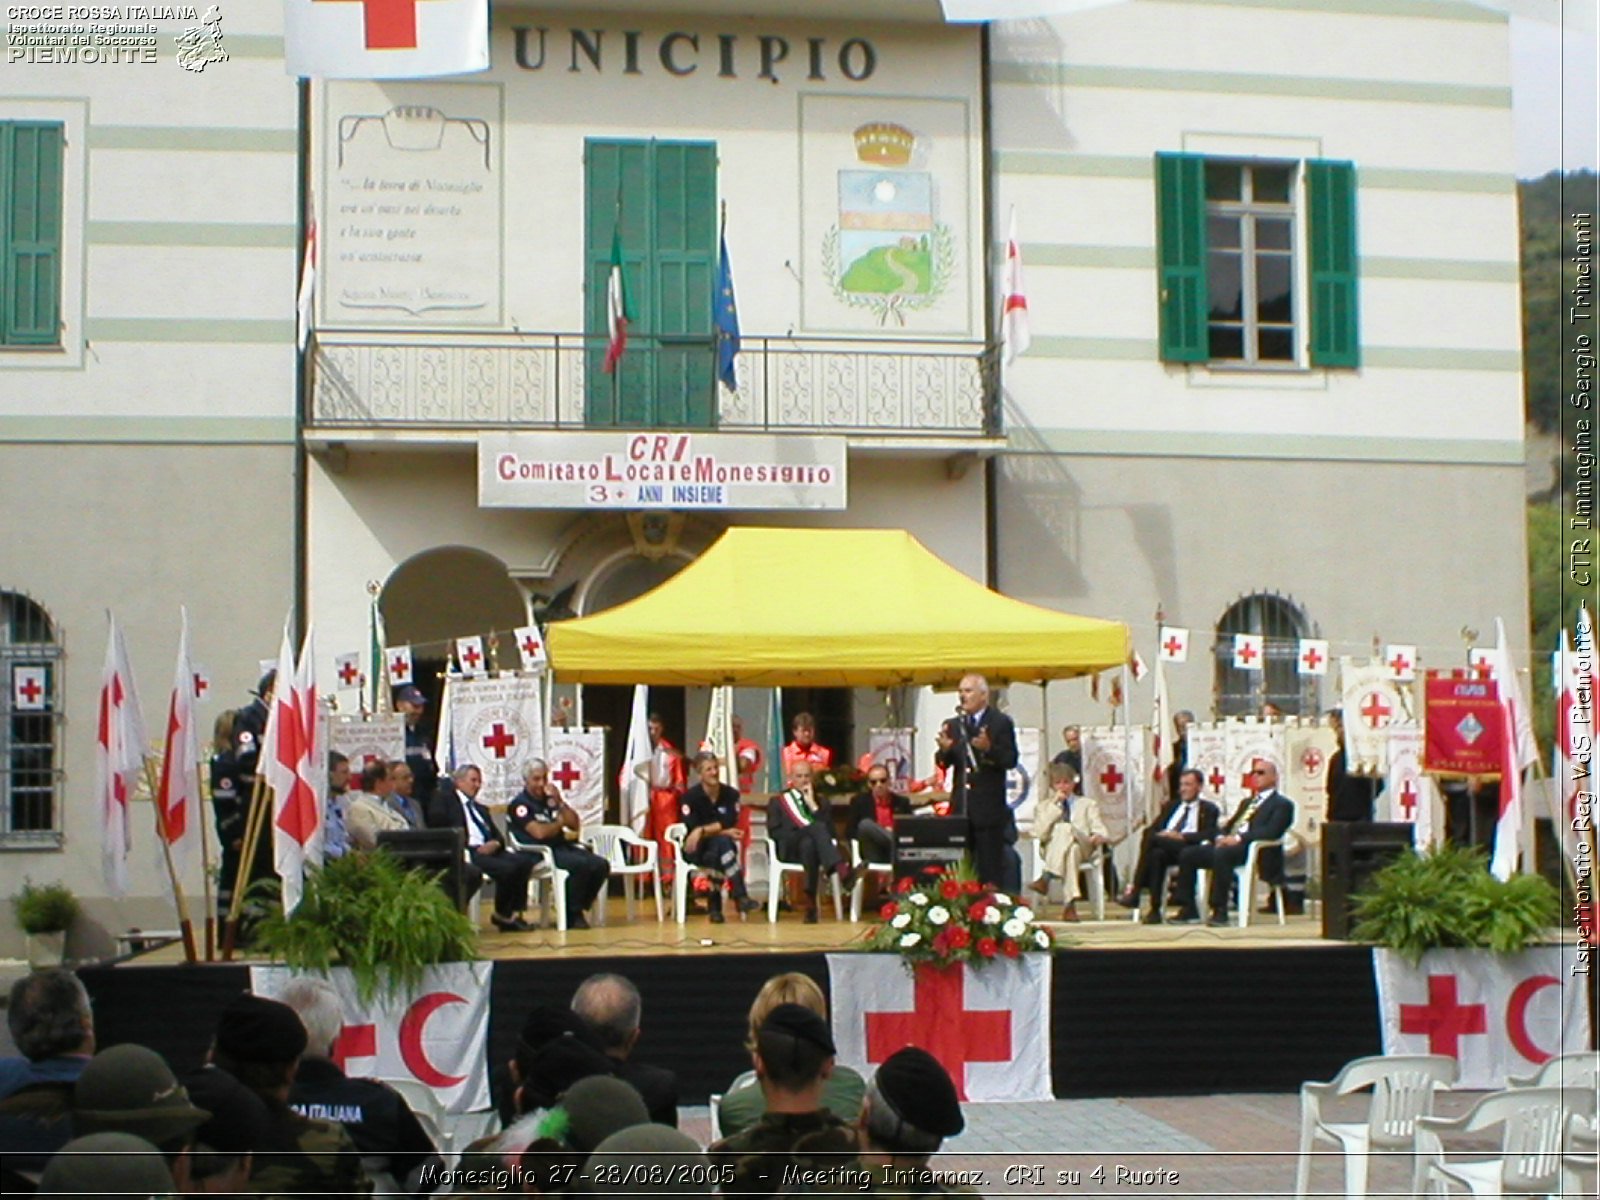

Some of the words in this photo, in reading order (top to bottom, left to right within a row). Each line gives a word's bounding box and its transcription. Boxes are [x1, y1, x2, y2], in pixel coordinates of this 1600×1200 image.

[511, 25, 877, 83] UNICIPIO
[630, 434, 690, 462] CRI
[499, 455, 599, 480] Comitato
[637, 485, 663, 503] ANNI
[672, 485, 723, 503] INSIEME
